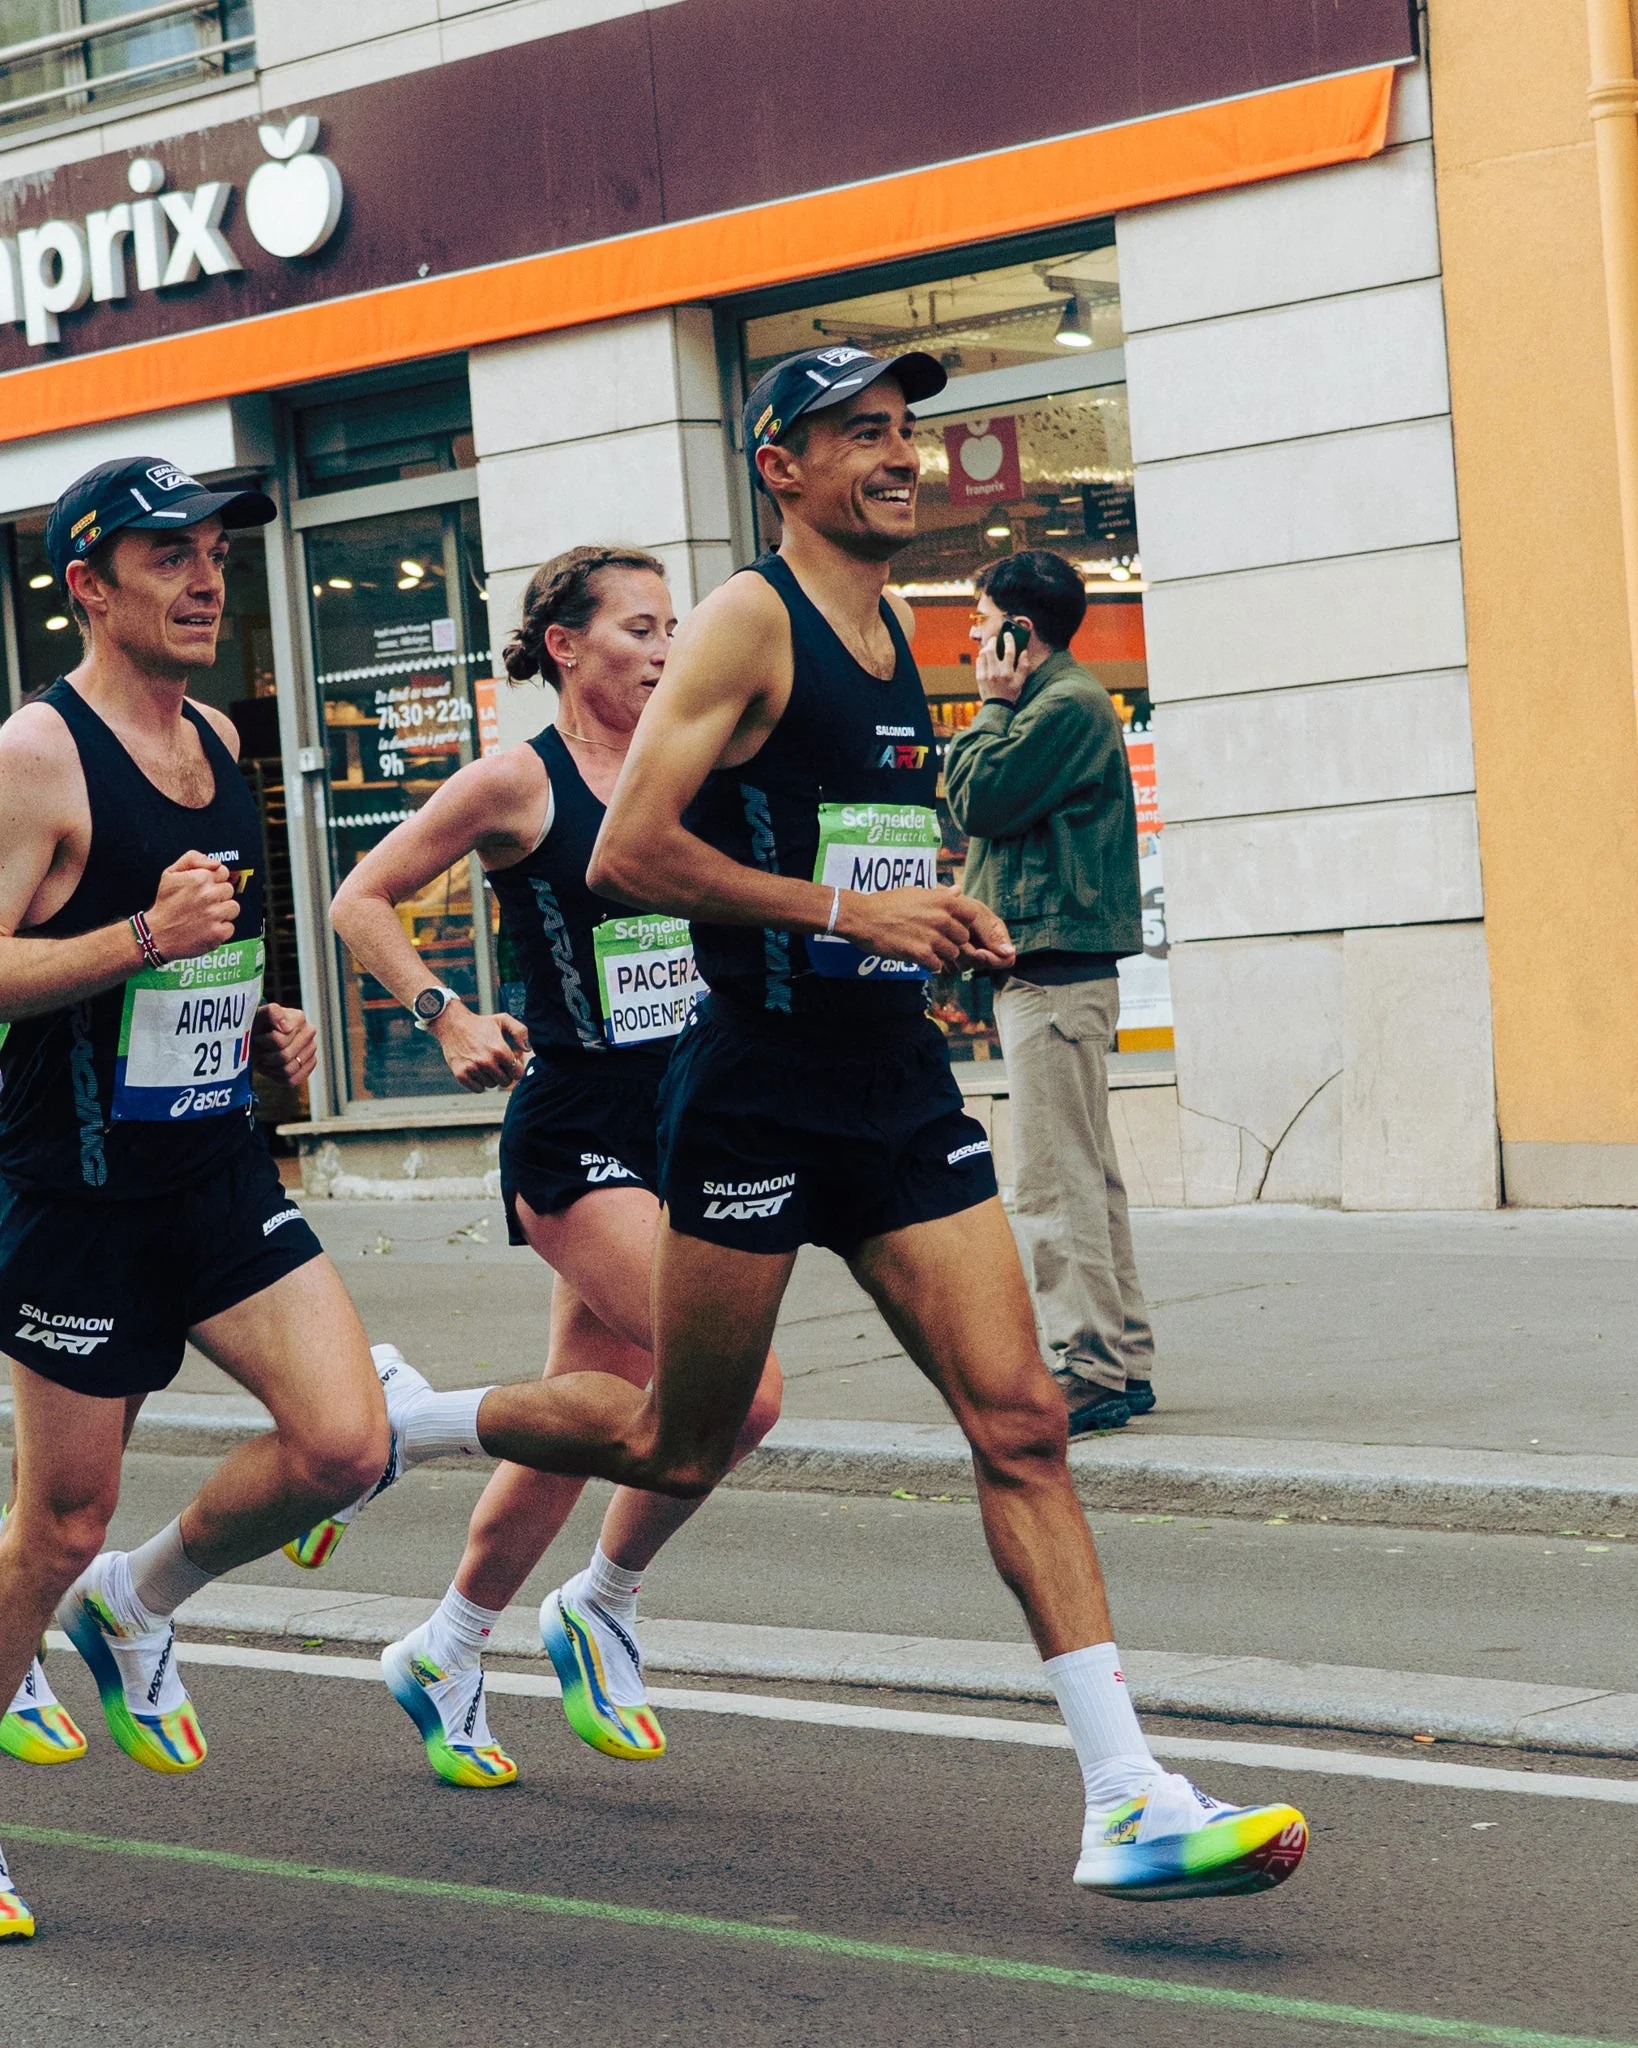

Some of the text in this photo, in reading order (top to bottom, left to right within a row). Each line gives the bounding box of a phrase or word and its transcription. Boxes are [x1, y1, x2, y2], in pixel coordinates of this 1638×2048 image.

[875, 725, 915, 737] SALOMON
[379, 752, 405, 777] 9h
[841, 807, 926, 829] Schneider
[884, 828, 928, 842] Electric
[196, 968, 241, 984] Electric
[617, 957, 689, 994] PACER
[175, 993, 246, 1036] AIRIAU
[193, 1040, 222, 1077] 29
[193, 1088, 233, 1111] asics
[703, 1173, 795, 1196] SALOMON
[703, 1191, 792, 1219] LART
[19, 1303, 114, 1331] SALOMON
[15, 1323, 109, 1355] LART
